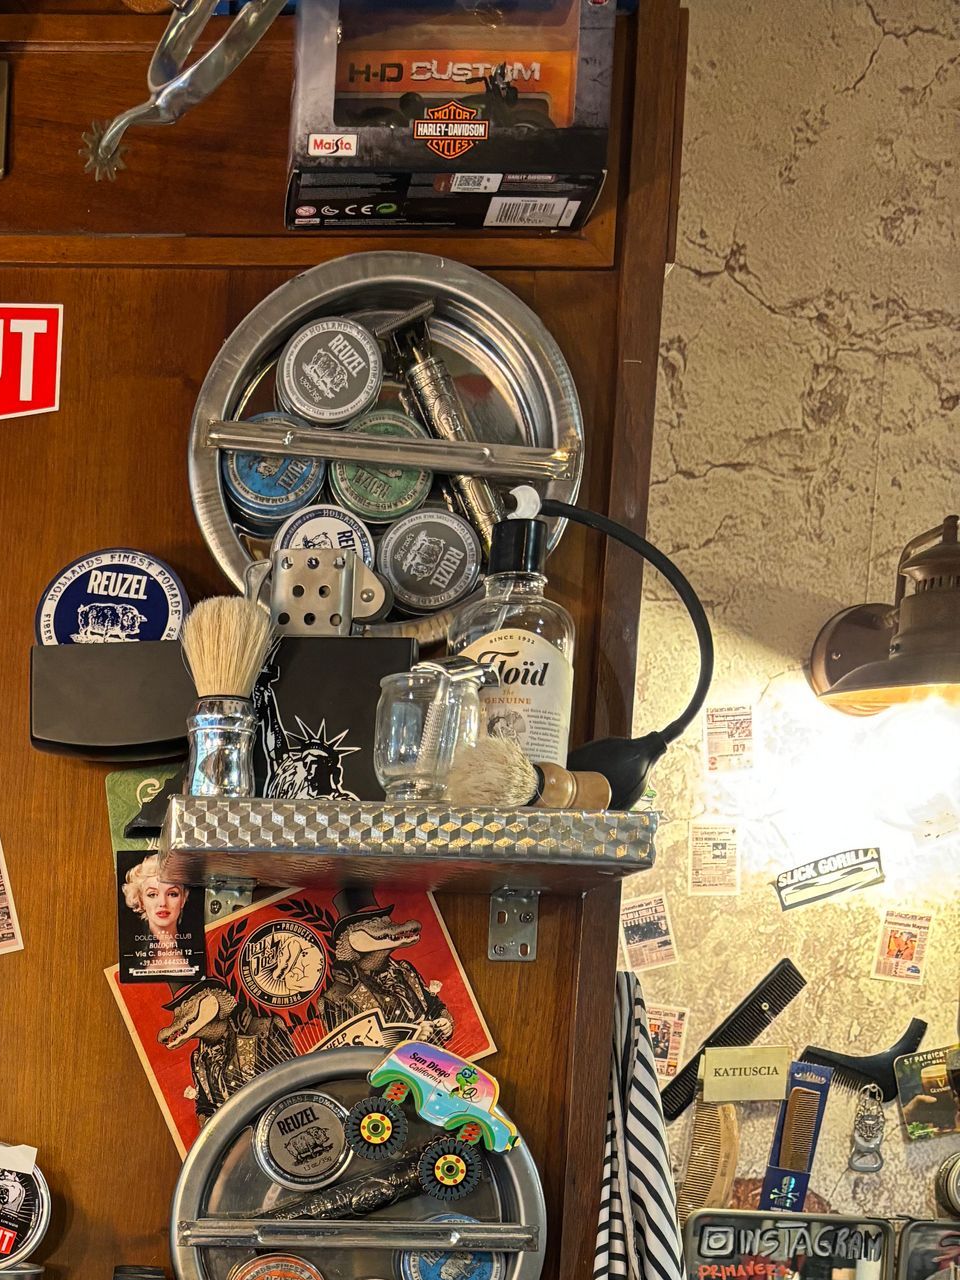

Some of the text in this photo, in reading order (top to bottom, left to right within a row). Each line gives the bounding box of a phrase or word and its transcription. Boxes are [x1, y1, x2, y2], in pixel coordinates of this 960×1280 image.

[434, 107, 471, 119] MOTOR
[418, 124, 485, 136] HARLEY-DAVIDSON
[313, 138, 352, 155] Maisto
[433, 142, 468, 155] CYCLES
[328, 334, 366, 377] REUZEL
[429, 547, 464, 589] REUZEL
[48, 554, 178, 616] HOLLANDS FINEST POMADE
[87, 570, 148, 600] REUZEL
[490, 635, 535, 645] SINCE 1932
[778, 848, 878, 887] SLICK GORILLA
[281, 923, 312, 940] PRODUCTS
[409, 1052, 450, 1078] San Diego
[903, 1056, 914, 1064] ST
[713, 1066, 779, 1077] KATIUSCIA
[277, 1107, 319, 1136] REUZEL
[740, 1221, 883, 1262] INSTAGRAM
